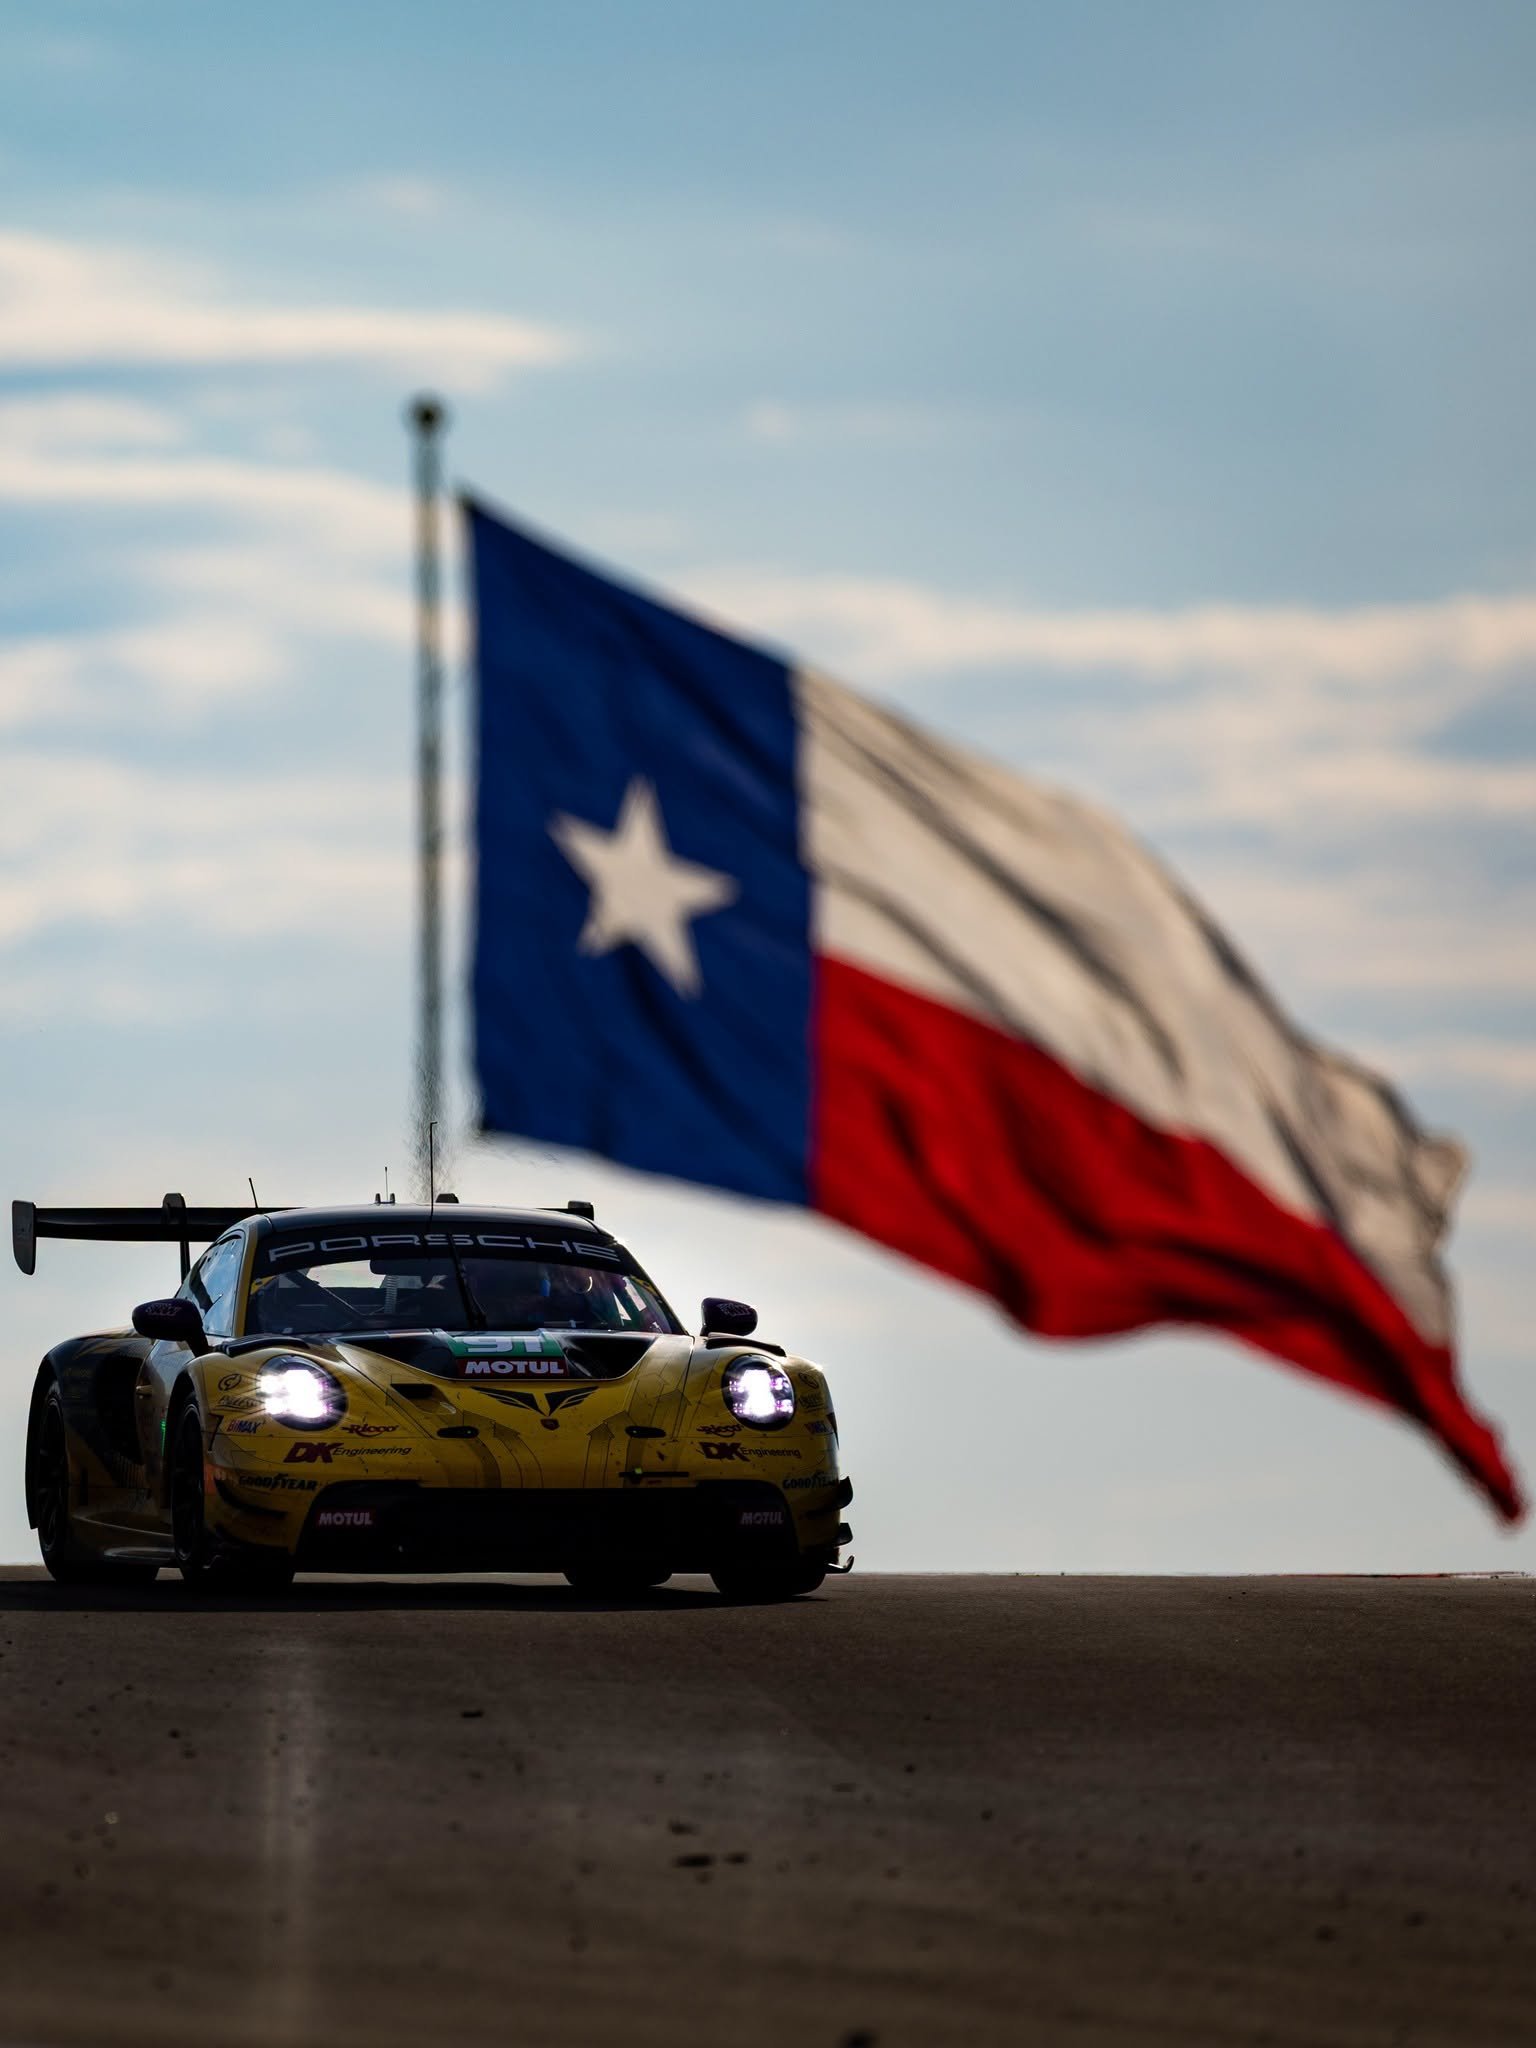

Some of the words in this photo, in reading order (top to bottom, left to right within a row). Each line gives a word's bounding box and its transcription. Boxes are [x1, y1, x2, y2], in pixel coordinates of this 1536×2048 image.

[267, 1234, 621, 1263] PORSCHE
[464, 1360, 565, 1374] MOTUL
[283, 1442, 344, 1464] DK
[332, 1446, 412, 1457] Engineering
[699, 1441, 751, 1462] DK
[740, 1447, 802, 1459] Engineering
[319, 1511, 374, 1526] MOTUL
[739, 1511, 784, 1526] MOTUL
